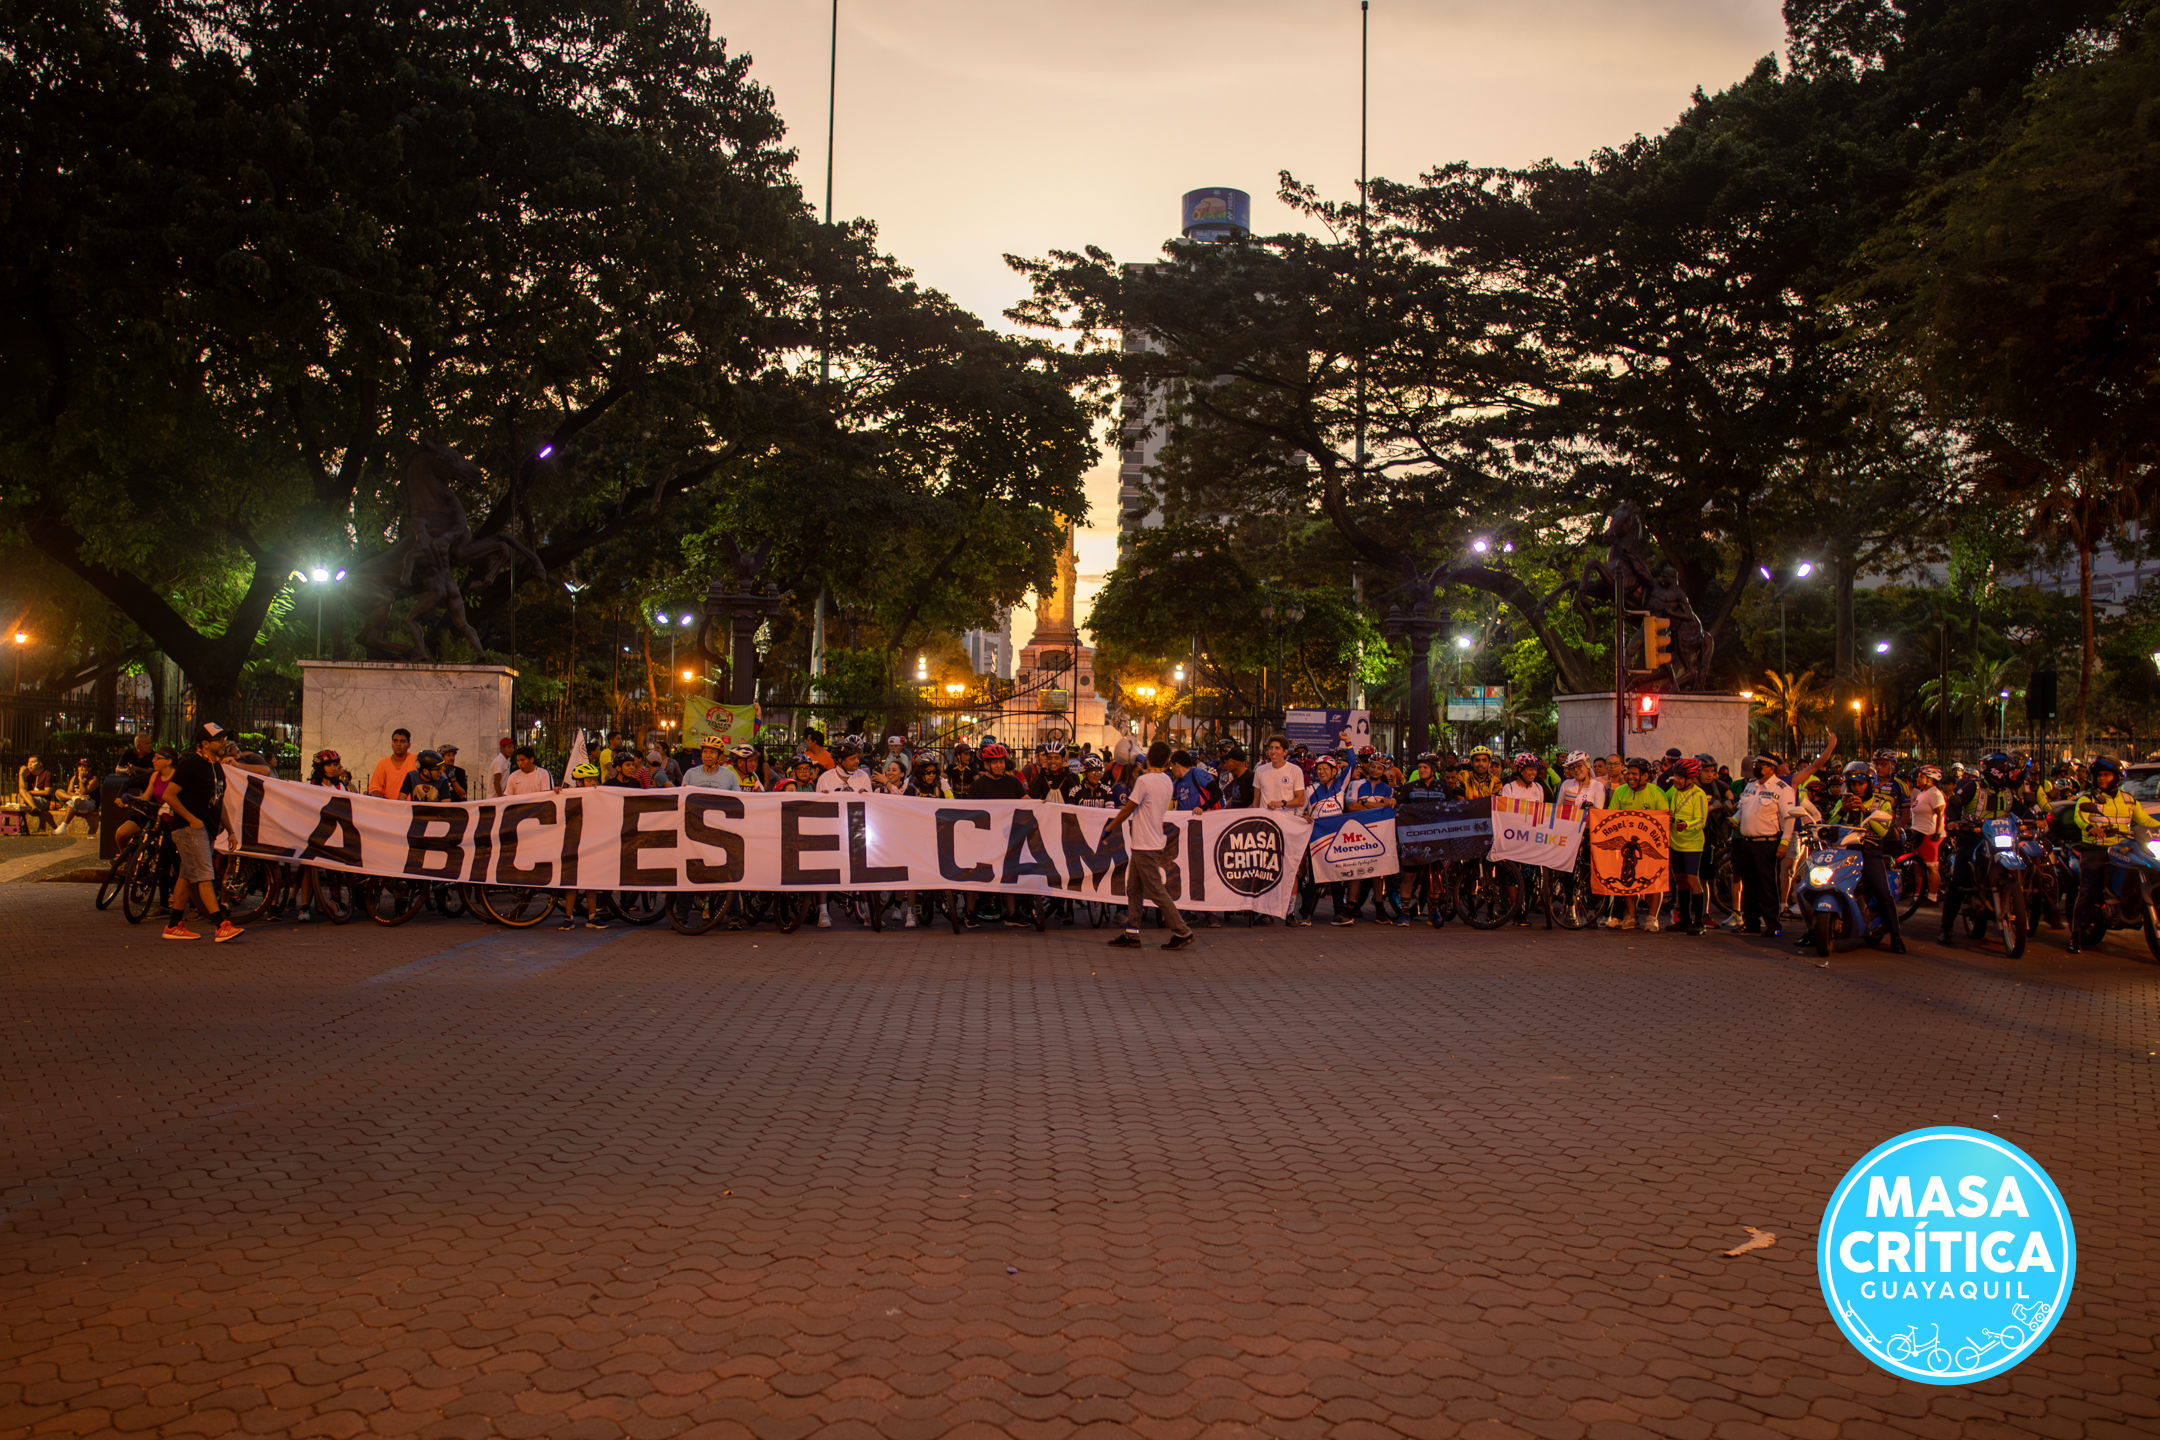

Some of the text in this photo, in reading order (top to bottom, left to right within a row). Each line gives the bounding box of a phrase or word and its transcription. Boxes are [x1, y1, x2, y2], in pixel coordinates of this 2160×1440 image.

[1991, 767, 2004, 779] 154
[1990, 819, 2010, 827] ATM
[241, 775, 363, 867] LA
[403, 797, 583, 886] BICI
[619, 793, 745, 886] ES
[781, 800, 909, 885] EL
[1406, 825, 1471, 837] CORONABIKE
[1602, 820, 1662, 848] Angel's On Bike
[1995, 826, 2010, 835] 154
[1229, 831, 1276, 851] MASA
[1342, 832, 1366, 843] Mr.
[1504, 828, 1568, 847] OM BIKE
[1333, 842, 1379, 854] Morocho
[1223, 850, 1279, 872] CRITICA
[1816, 853, 1834, 863] 68
[2109, 848, 2131, 863] RANSITO
[1226, 869, 1275, 881] GUAYAQUIL
